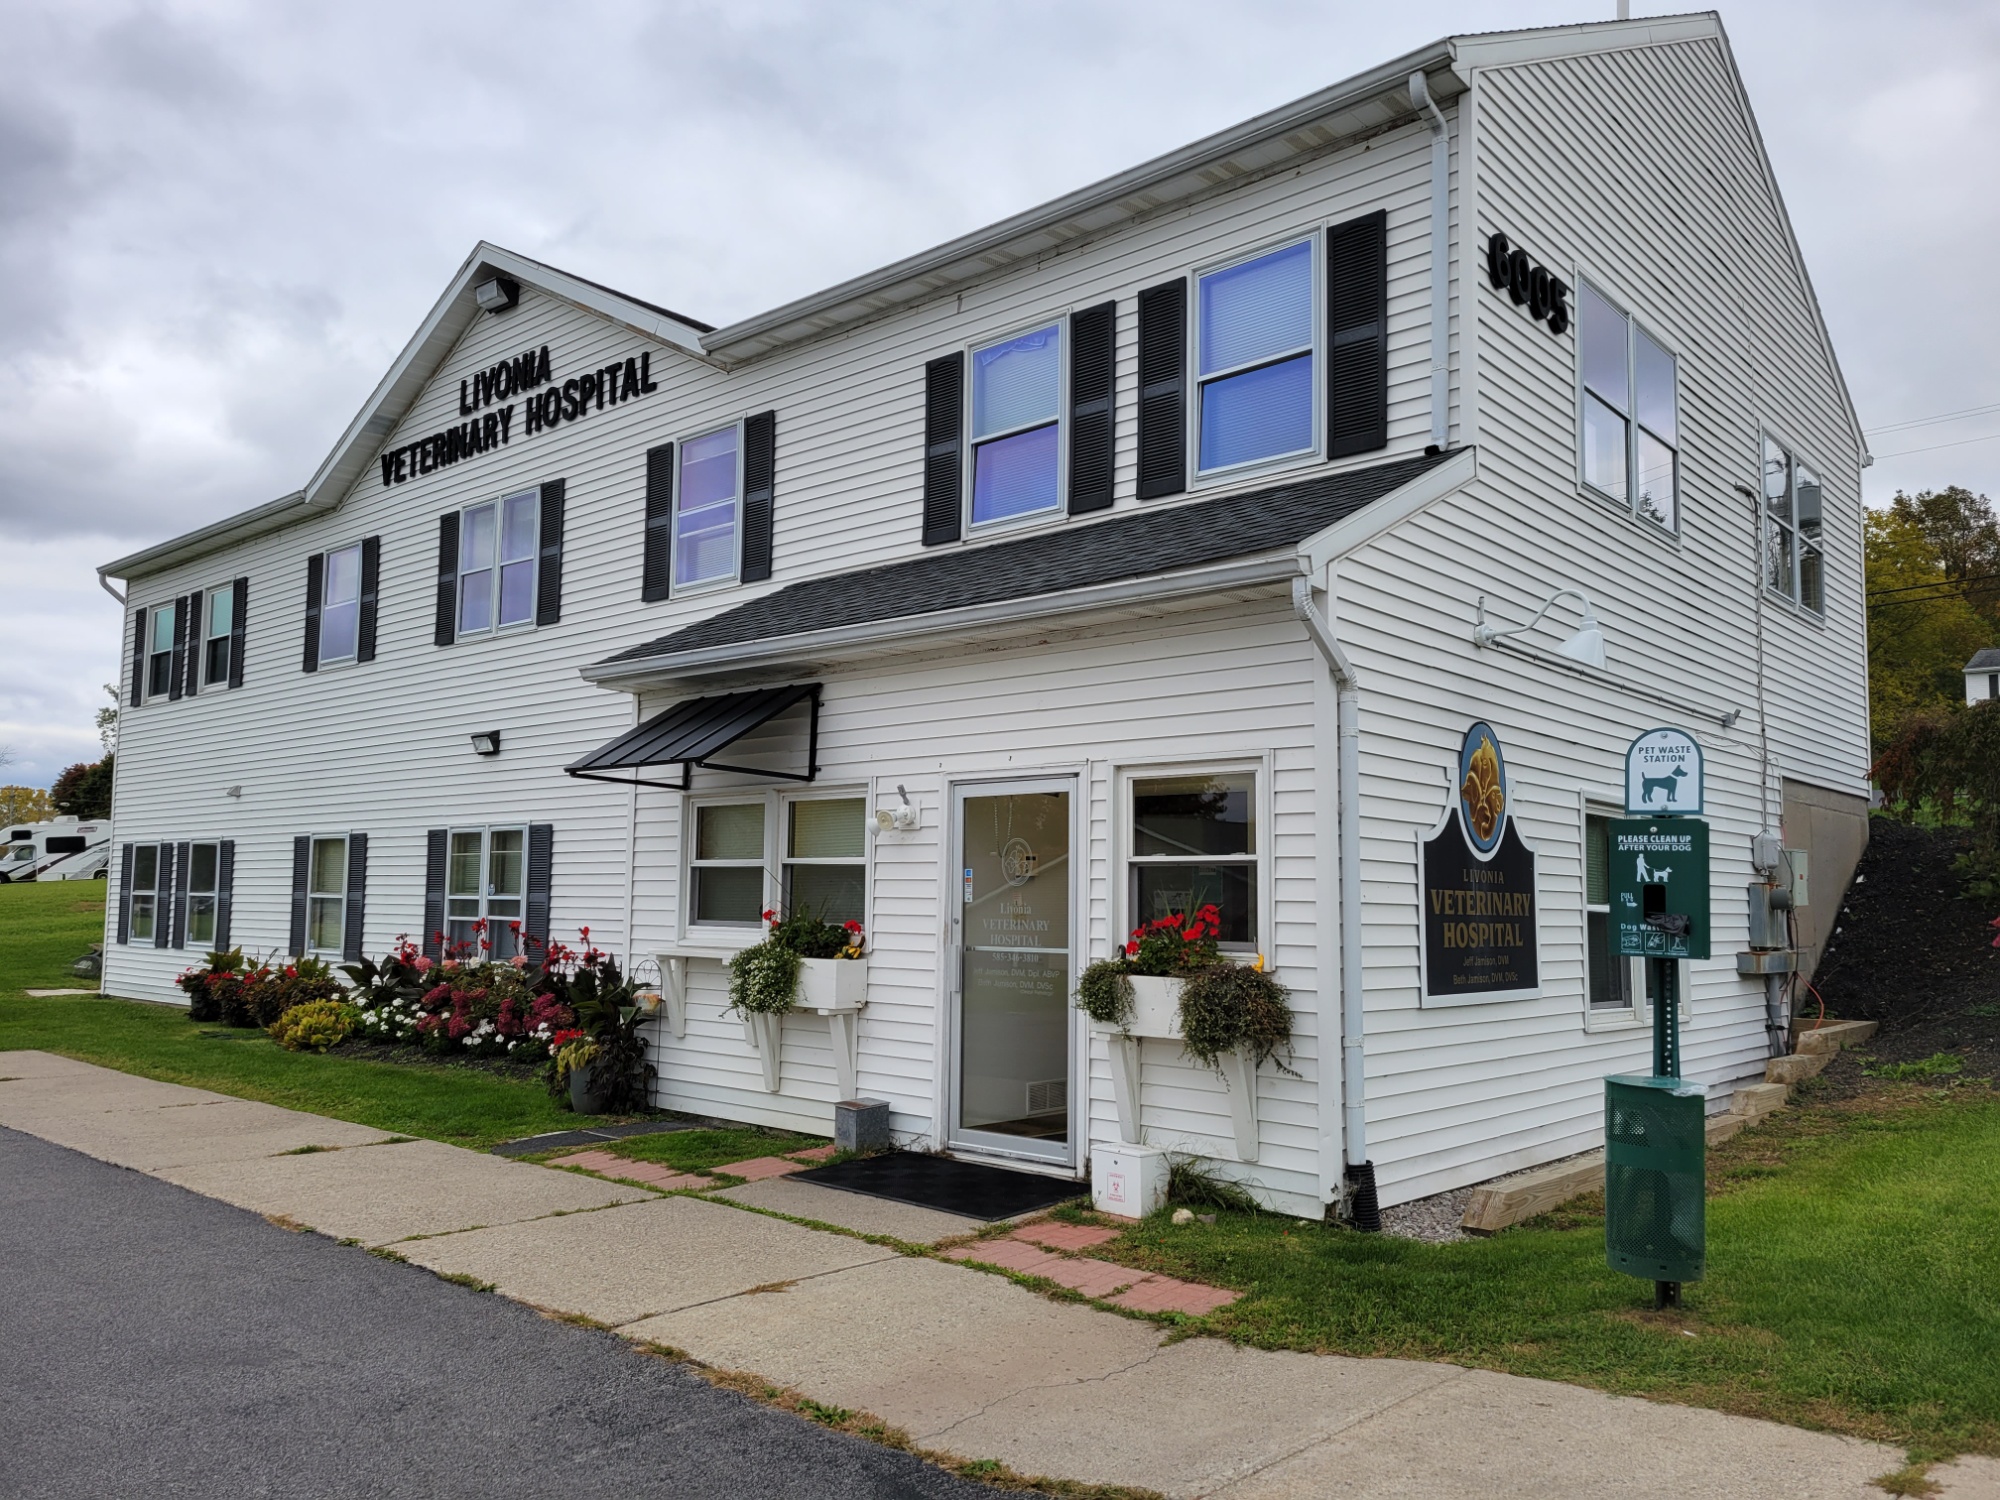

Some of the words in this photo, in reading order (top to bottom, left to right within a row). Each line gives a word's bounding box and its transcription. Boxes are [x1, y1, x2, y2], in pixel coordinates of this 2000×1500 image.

[1487, 232, 1569, 336] 6005
[459, 345, 551, 416] LIVONIA
[381, 404, 514, 487] VETERINARY
[525, 351, 658, 436] HOSPITAL
[1638, 746, 1656, 755] PET
[1658, 745, 1691, 754] WASTE
[1643, 754, 1686, 763] STATION
[1617, 834, 1649, 843] PLEASE
[1650, 834, 1678, 843] CLEAN
[1679, 834, 1692, 843] UP
[1463, 868, 1505, 885] LIVONIA
[1000, 902, 1032, 915] Livonia
[1430, 888, 1531, 917] VETERINARY
[983, 918, 1050, 932] VETERINARY
[1620, 923, 1638, 932] Dog
[990, 934, 1041, 947] HOSPITAL
[1443, 921, 1524, 949] HOSPITAL
[1463, 955, 1474, 967] Jeff
[1497, 954, 1510, 965] DVM
[1453, 973, 1467, 985] Beth
